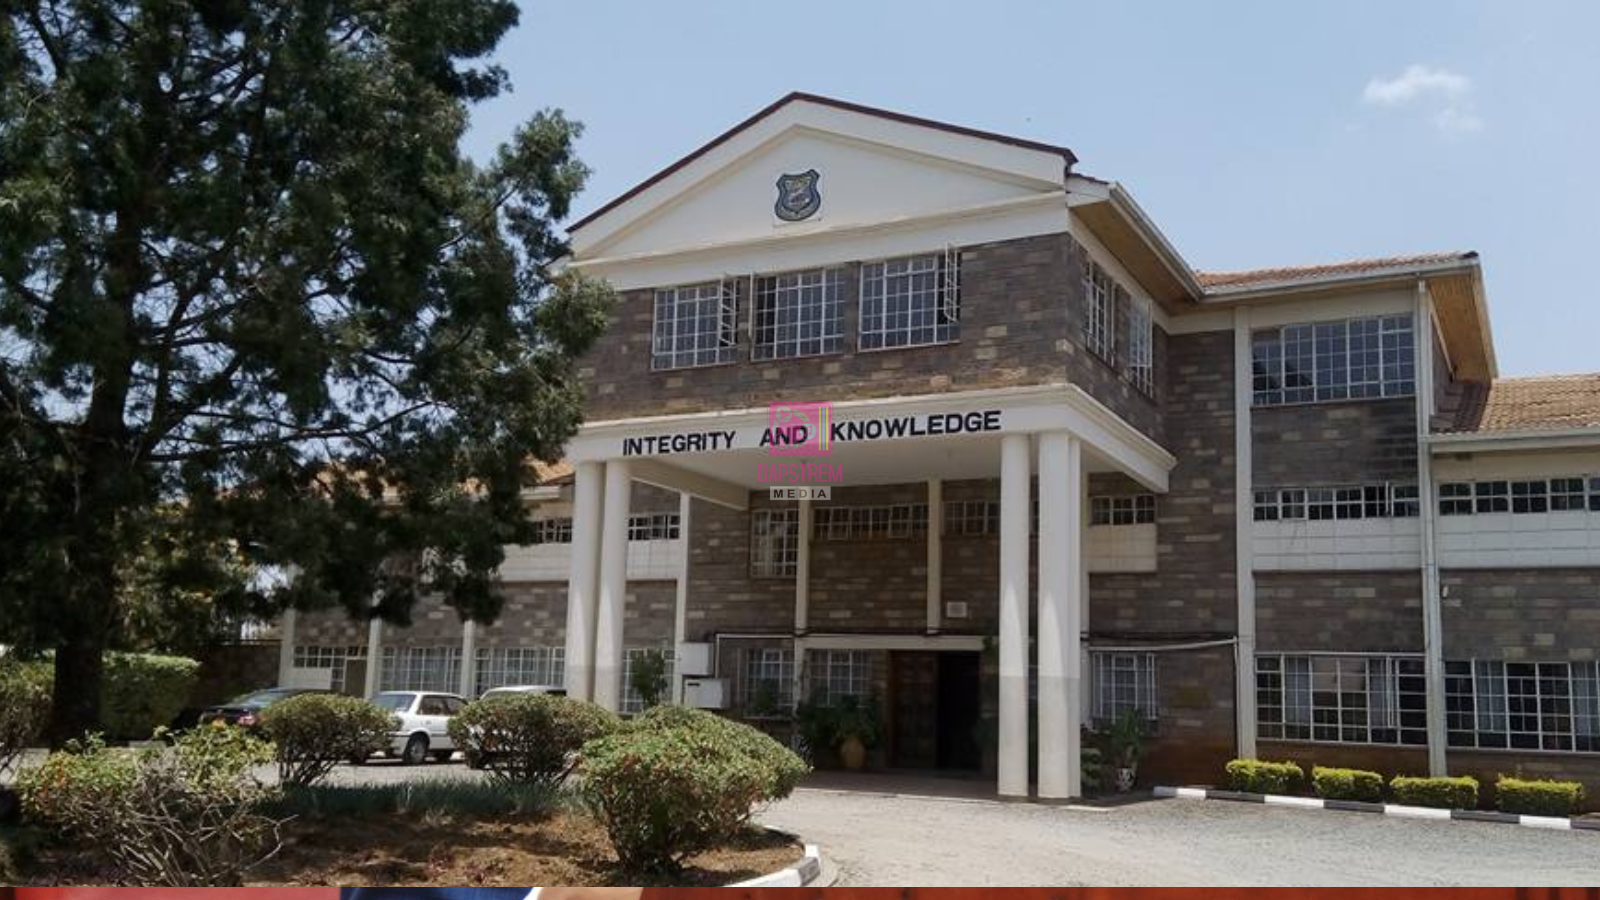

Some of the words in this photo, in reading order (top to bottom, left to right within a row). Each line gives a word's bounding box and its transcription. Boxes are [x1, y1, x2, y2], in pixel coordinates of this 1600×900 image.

[622, 430, 737, 456] INTEGRITY
[759, 425, 808, 447] AND
[830, 410, 1002, 442] KNOWLEDGE
